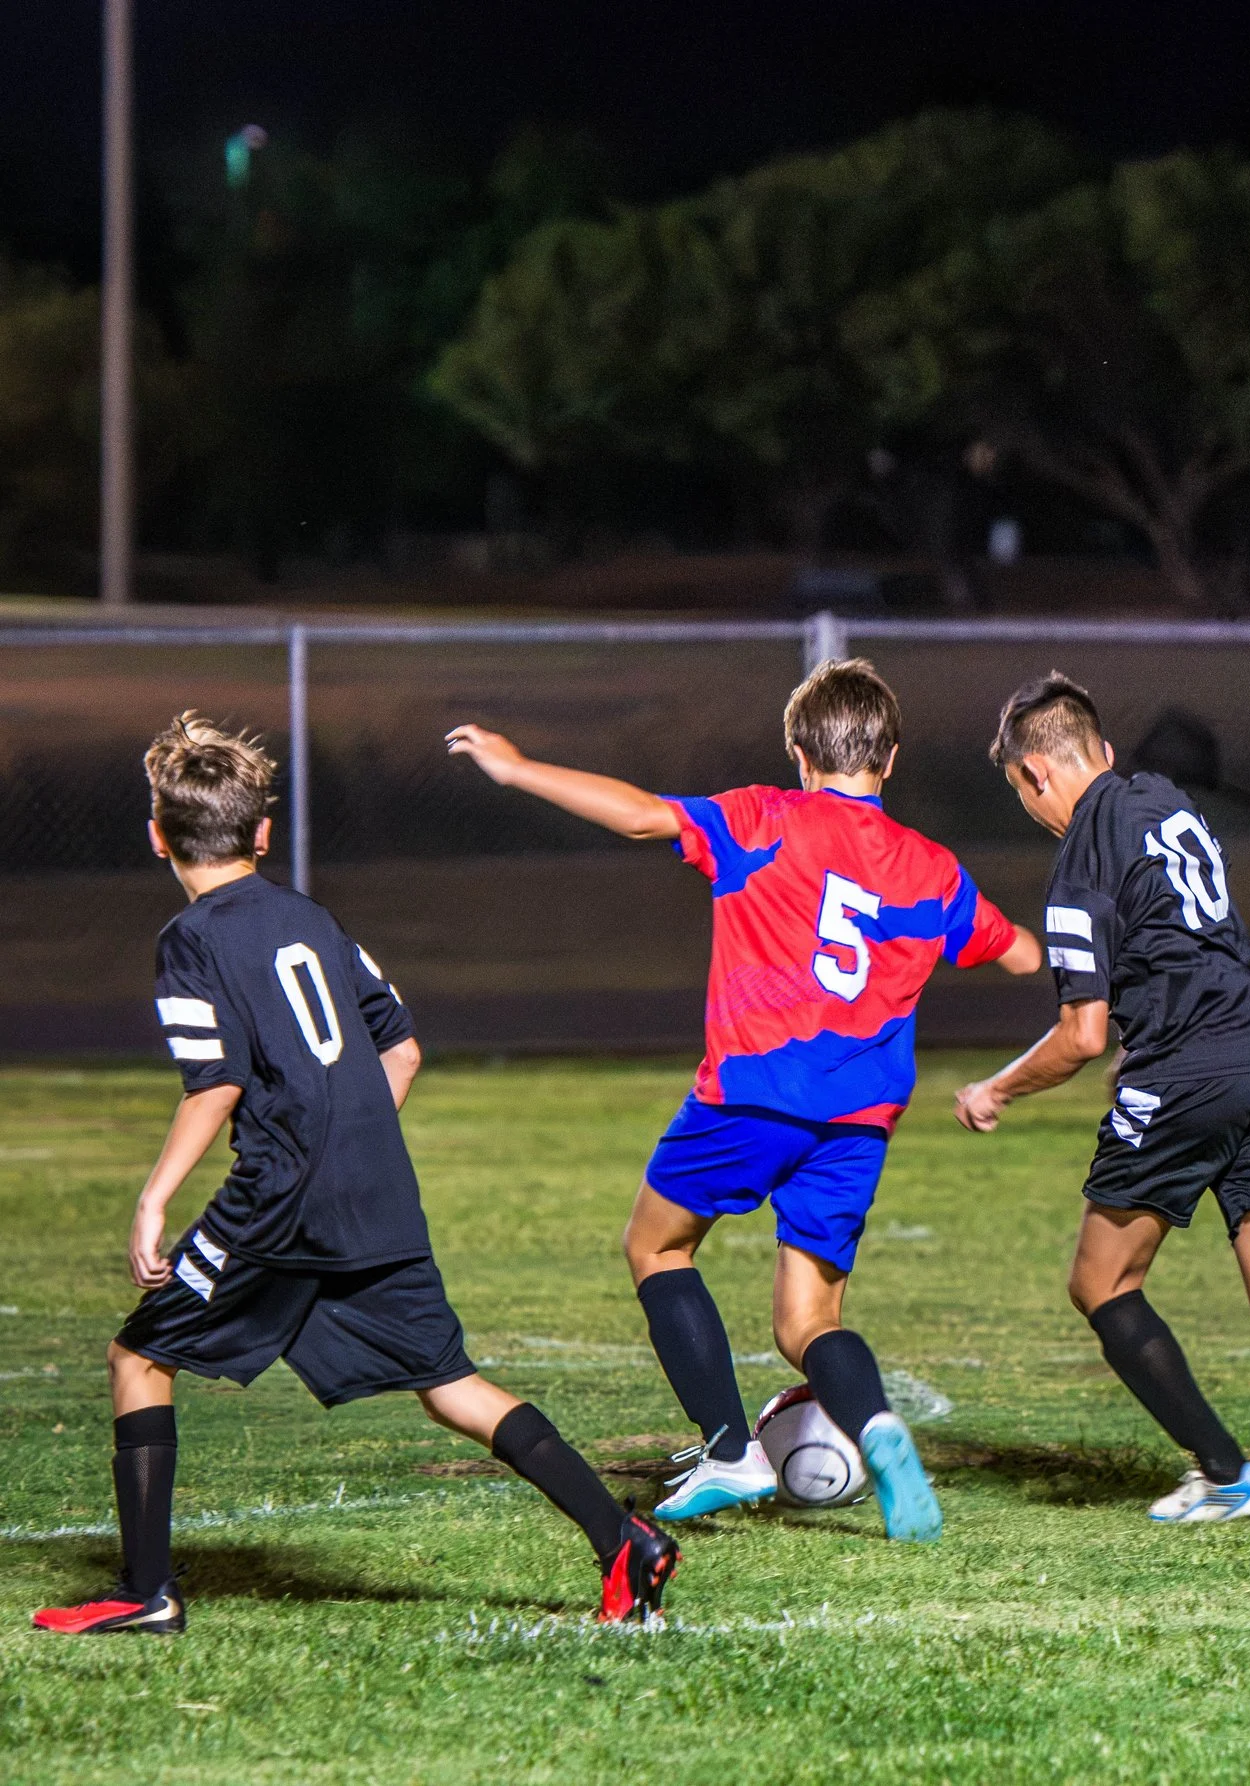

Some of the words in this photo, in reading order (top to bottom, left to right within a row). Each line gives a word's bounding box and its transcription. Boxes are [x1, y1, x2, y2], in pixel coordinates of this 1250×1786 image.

[1143, 809, 1229, 930] 10
[812, 870, 882, 1003] 5
[274, 942, 344, 1066] 0
